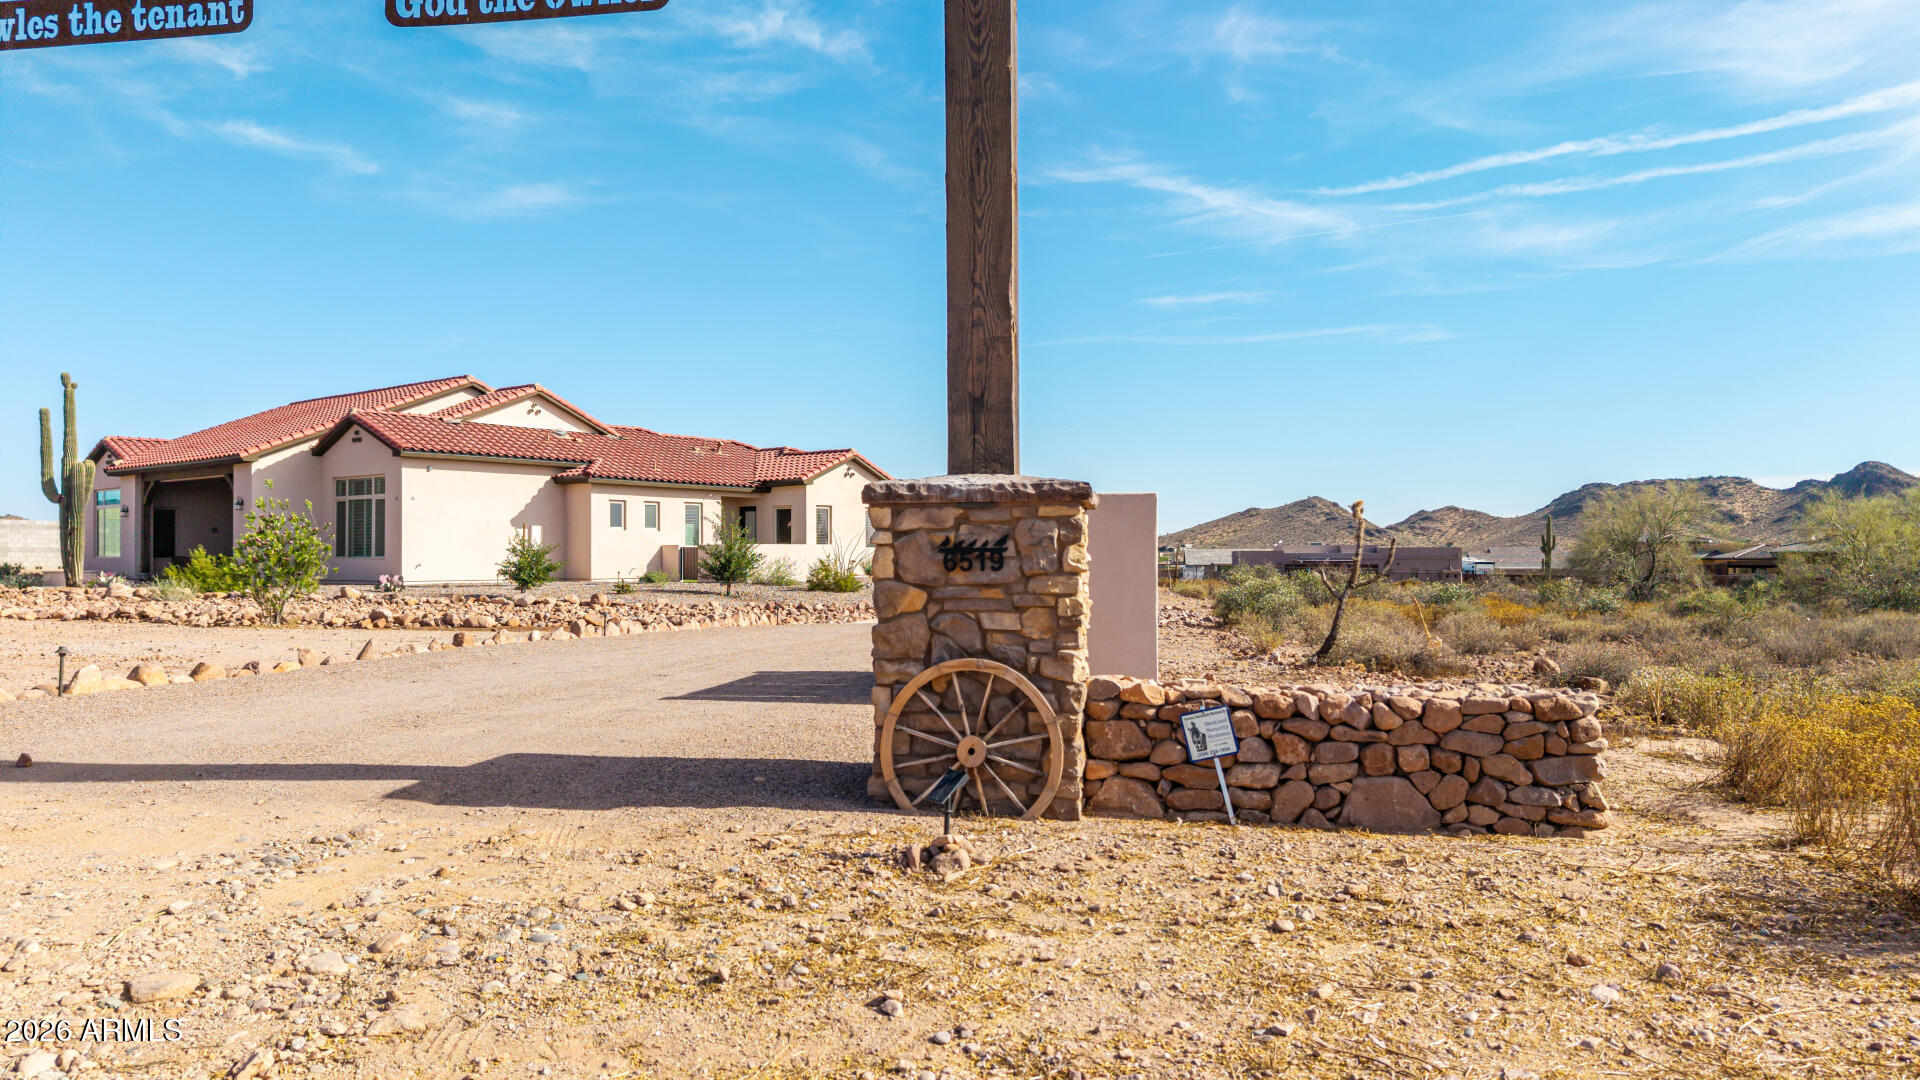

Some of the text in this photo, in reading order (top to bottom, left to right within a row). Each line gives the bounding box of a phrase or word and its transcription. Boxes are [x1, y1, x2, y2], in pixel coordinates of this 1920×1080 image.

[68, 2, 122, 37] the
[131, 0, 245, 32] tenant
[943, 549, 1004, 572] 6519
